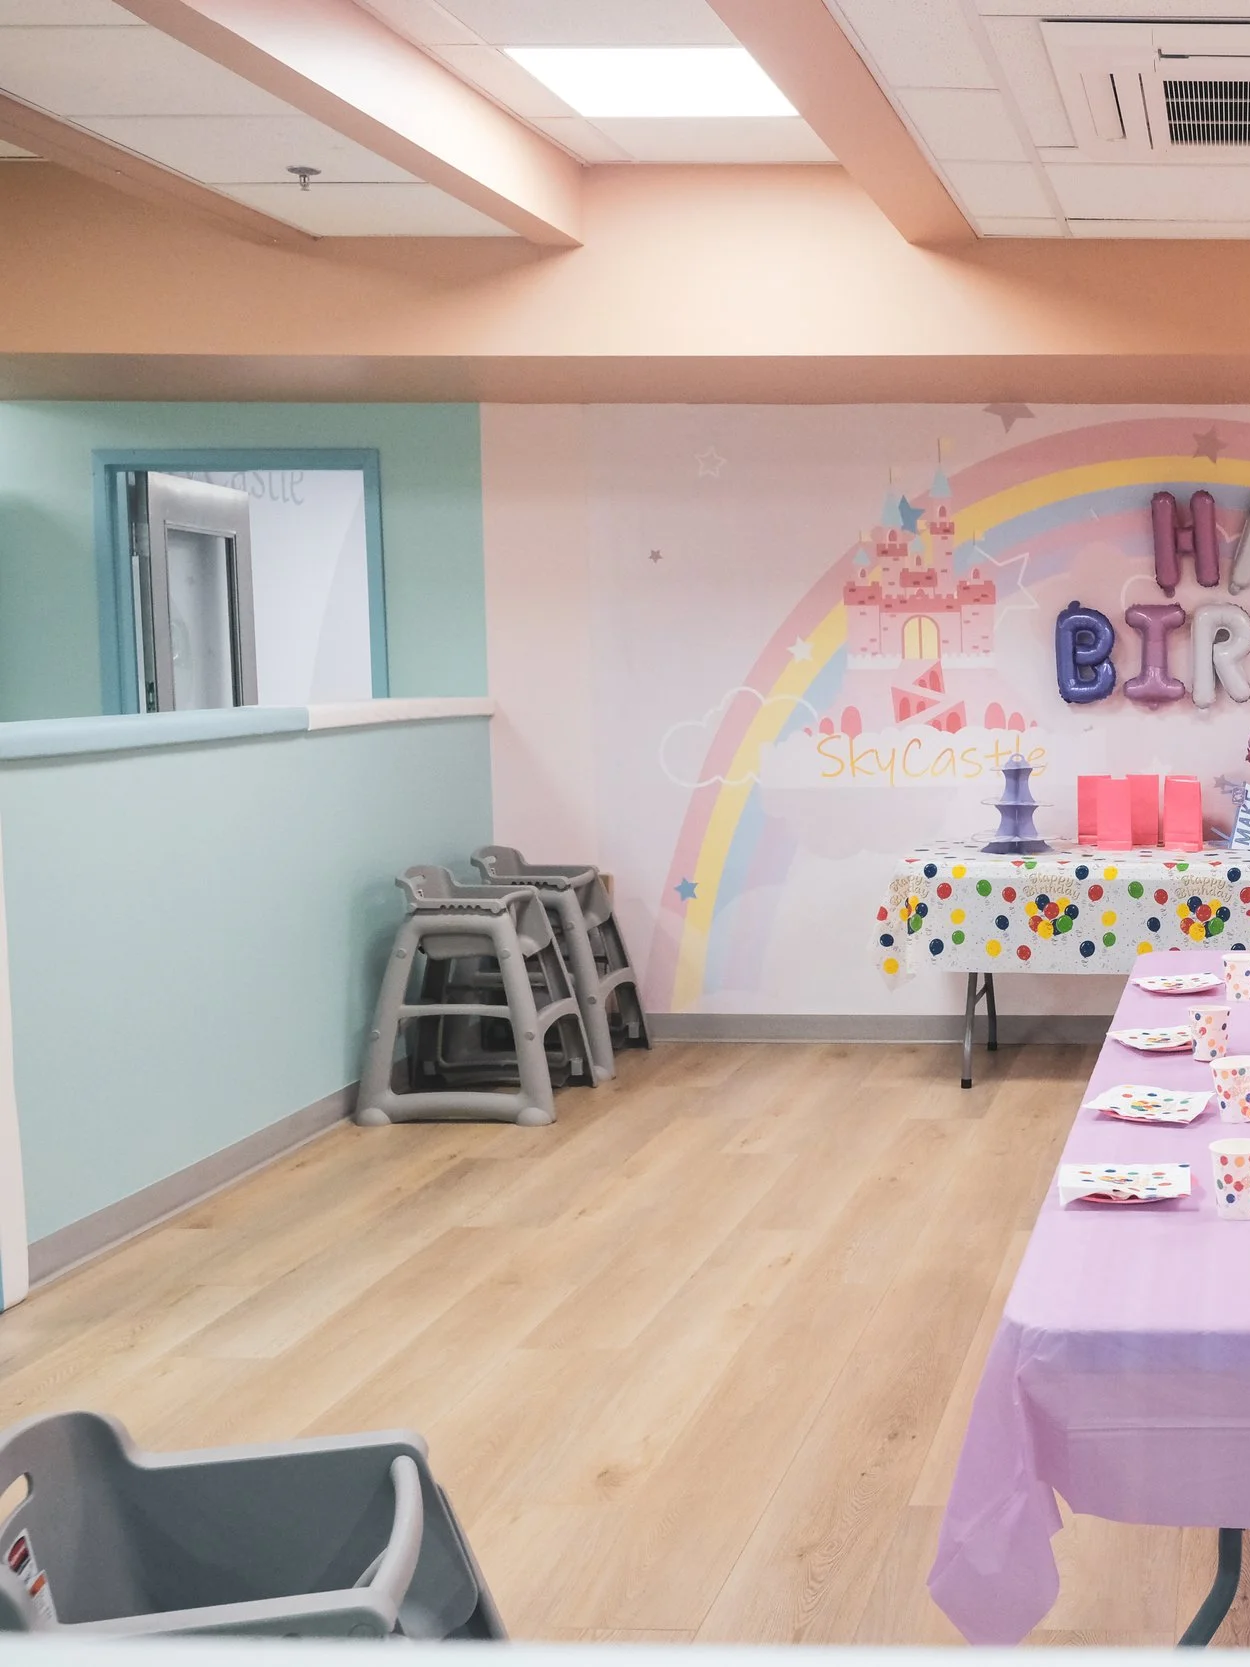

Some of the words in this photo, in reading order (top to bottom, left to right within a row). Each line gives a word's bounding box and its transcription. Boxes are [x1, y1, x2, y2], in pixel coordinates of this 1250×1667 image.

[1028, 872, 1074, 888] Happy
[1180, 874, 1226, 890] Happy
[1022, 884, 1081, 900] Birthday
[1174, 886, 1232, 903] Birthday
